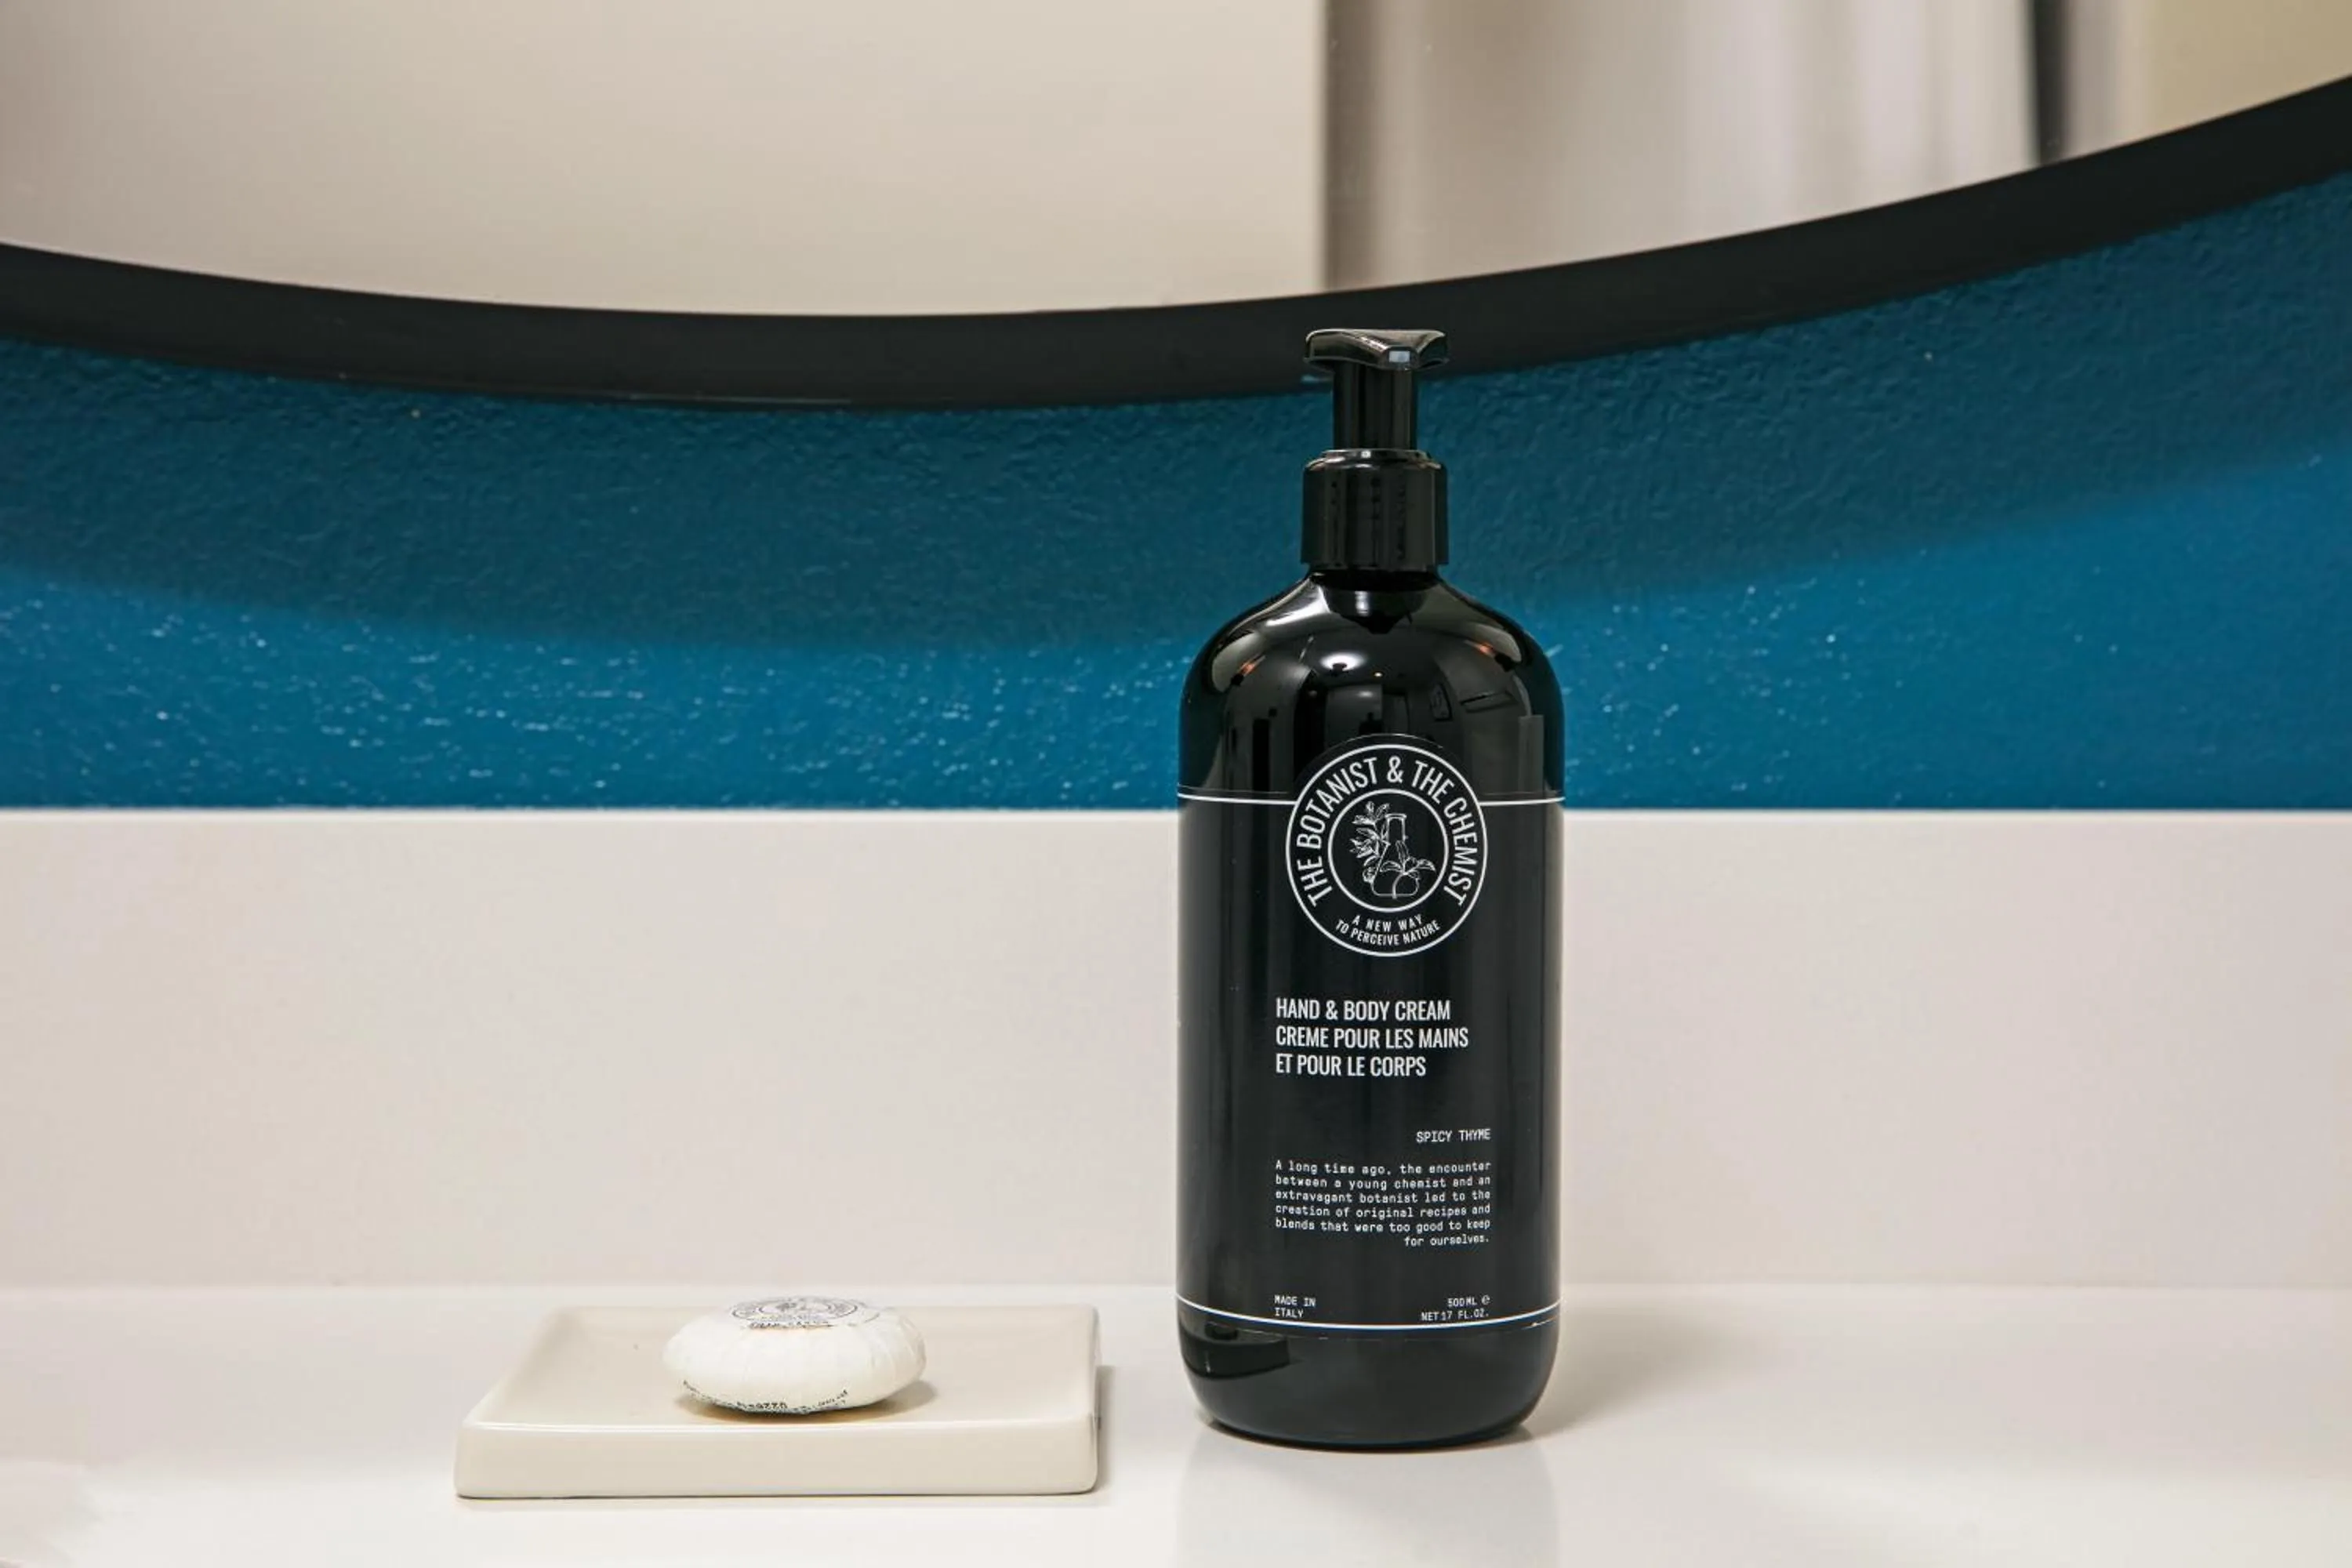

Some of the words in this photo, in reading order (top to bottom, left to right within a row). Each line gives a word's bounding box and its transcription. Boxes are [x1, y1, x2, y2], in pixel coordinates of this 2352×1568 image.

[1386, 755, 1404, 784] &
[1411, 760, 1454, 804] THE
[1296, 757, 1377, 849] BOTANIST
[1443, 797, 1479, 906] CHEMIST
[1297, 855, 1333, 907] THE
[1352, 914, 1360, 926] A
[1367, 919, 1392, 931] NEW
[1398, 913, 1423, 930] WAY
[1335, 919, 1349, 935] TO
[1350, 927, 1399, 946] PERCEIVE
[1403, 919, 1441, 944] NATURE
[1276, 996, 1320, 1020] HAND
[1325, 1000, 1338, 1021] &
[1343, 1000, 1391, 1022] BODY
[1395, 1000, 1451, 1022] CREAM
[1276, 1025, 1330, 1048] CREME
[1334, 1028, 1381, 1049] POUR
[1385, 1028, 1414, 1050] LES
[1418, 1026, 1469, 1048] MAINS
[1276, 1052, 1294, 1074] ET
[1297, 1054, 1342, 1076] POUR
[1347, 1056, 1366, 1076] LE
[1370, 1056, 1426, 1077] CORPS
[1416, 1130, 1453, 1144] SPICY
[1457, 1127, 1491, 1142] THYME
[1275, 1159, 1283, 1171] A
[1289, 1160, 1318, 1175] long
[1324, 1163, 1355, 1174] time
[1399, 1163, 1422, 1174] the
[1428, 1161, 1491, 1174] encounter
[1275, 1174, 1327, 1189] between
[1334, 1179, 1341, 1188] a
[1348, 1180, 1387, 1192] young
[1394, 1177, 1446, 1189] chemist
[1452, 1175, 1473, 1188] and
[1478, 1176, 1491, 1186] an
[1275, 1189, 1353, 1204] extravagant
[1359, 1192, 1418, 1203] botanist
[1425, 1191, 1446, 1203] led
[1452, 1191, 1465, 1202] to
[1472, 1189, 1491, 1200] the
[1275, 1205, 1330, 1218] creation
[1335, 1207, 1350, 1218] of
[1356, 1207, 1414, 1221] original
[1420, 1206, 1467, 1218] recipes
[1472, 1203, 1490, 1215] and
[1275, 1218, 1315, 1231] blends
[1319, 1221, 1349, 1232] that
[1354, 1224, 1384, 1232] were
[1388, 1222, 1410, 1233] too
[1415, 1221, 1443, 1235] good
[1448, 1220, 1462, 1230] to
[1467, 1219, 1490, 1230] keep
[1403, 1235, 1425, 1247] for
[1429, 1233, 1489, 1246] ourselves.
[1274, 1294, 1298, 1306] MADE
[1303, 1297, 1316, 1307] IN
[1447, 1296, 1478, 1308] 500ML
[1274, 1307, 1304, 1319] ITALY
